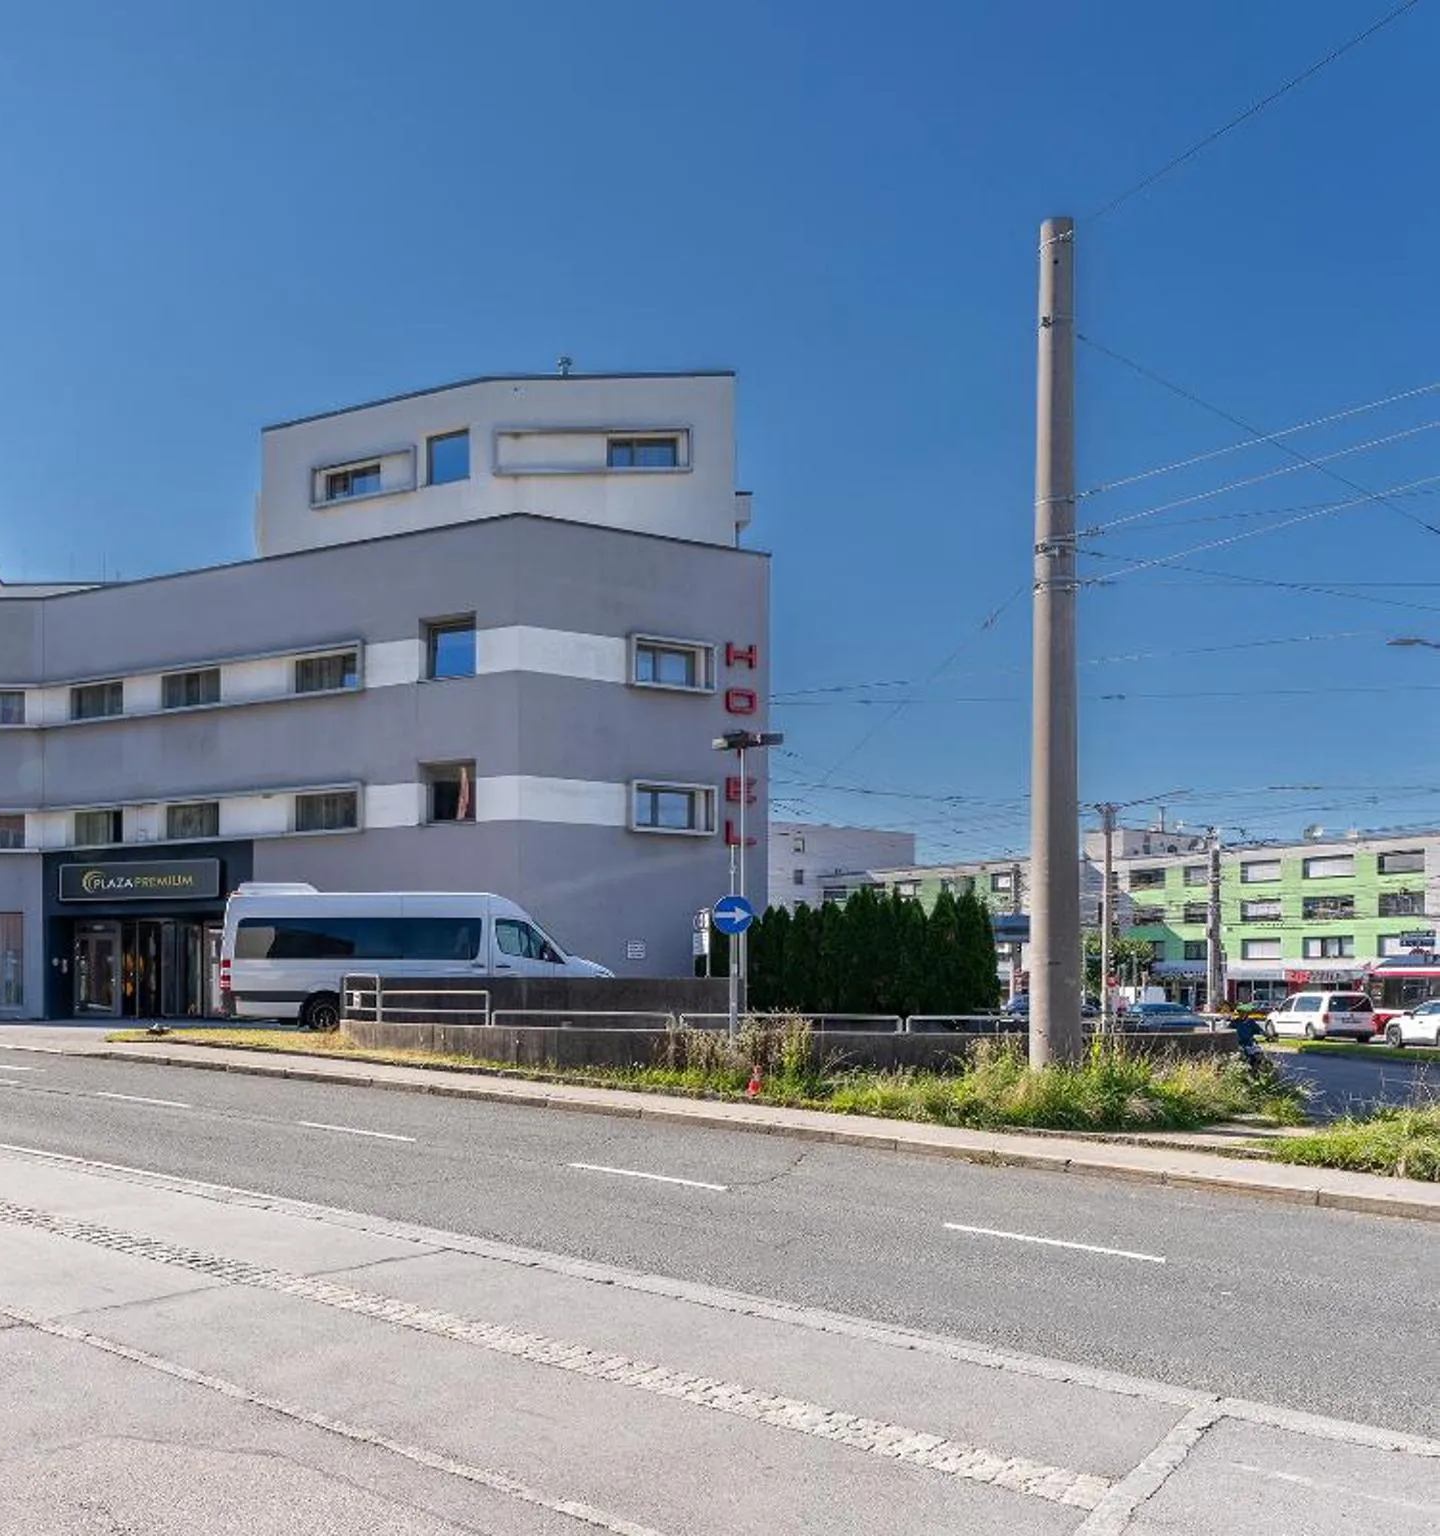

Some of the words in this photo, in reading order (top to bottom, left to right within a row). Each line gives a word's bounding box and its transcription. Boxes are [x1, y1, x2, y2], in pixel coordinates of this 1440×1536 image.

[725, 641, 758, 846] HOEL
[93, 876, 134, 889] PLAZA
[134, 874, 193, 888] PREMIUM
